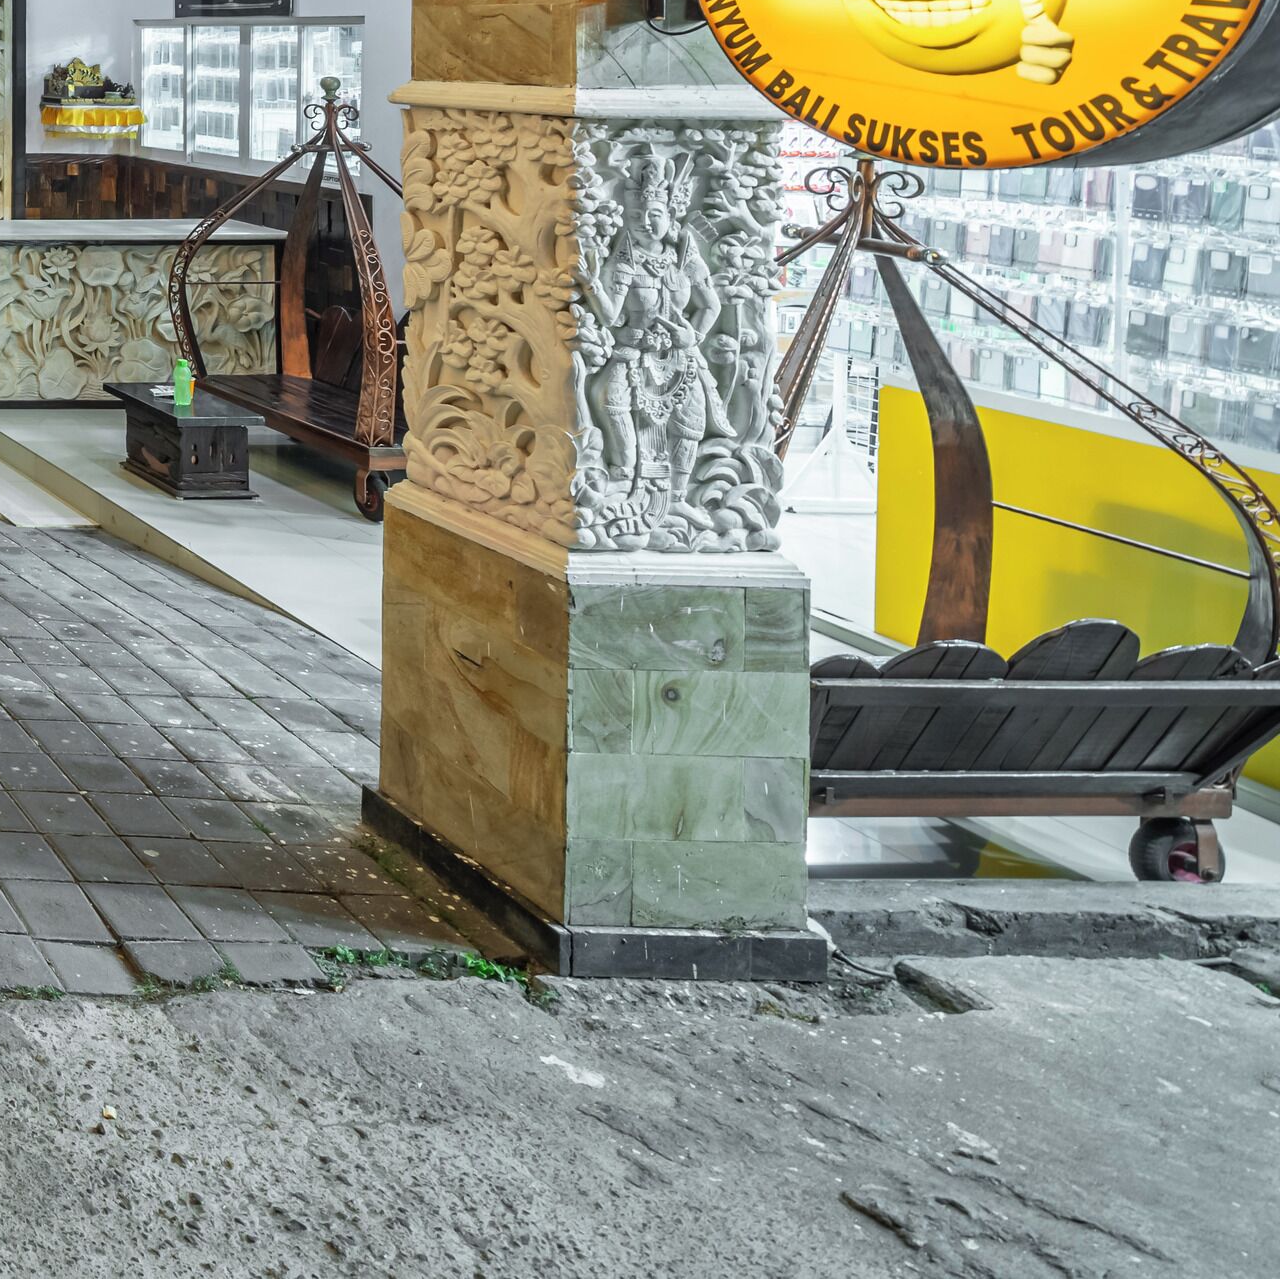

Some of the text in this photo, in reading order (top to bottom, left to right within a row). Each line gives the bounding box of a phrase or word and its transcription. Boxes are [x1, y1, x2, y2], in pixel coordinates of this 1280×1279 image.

[764, 69, 840, 132] BALI
[843, 113, 988, 166] SUKSES
[1011, 93, 1140, 160] TOUR
[1120, 76, 1176, 110] &
